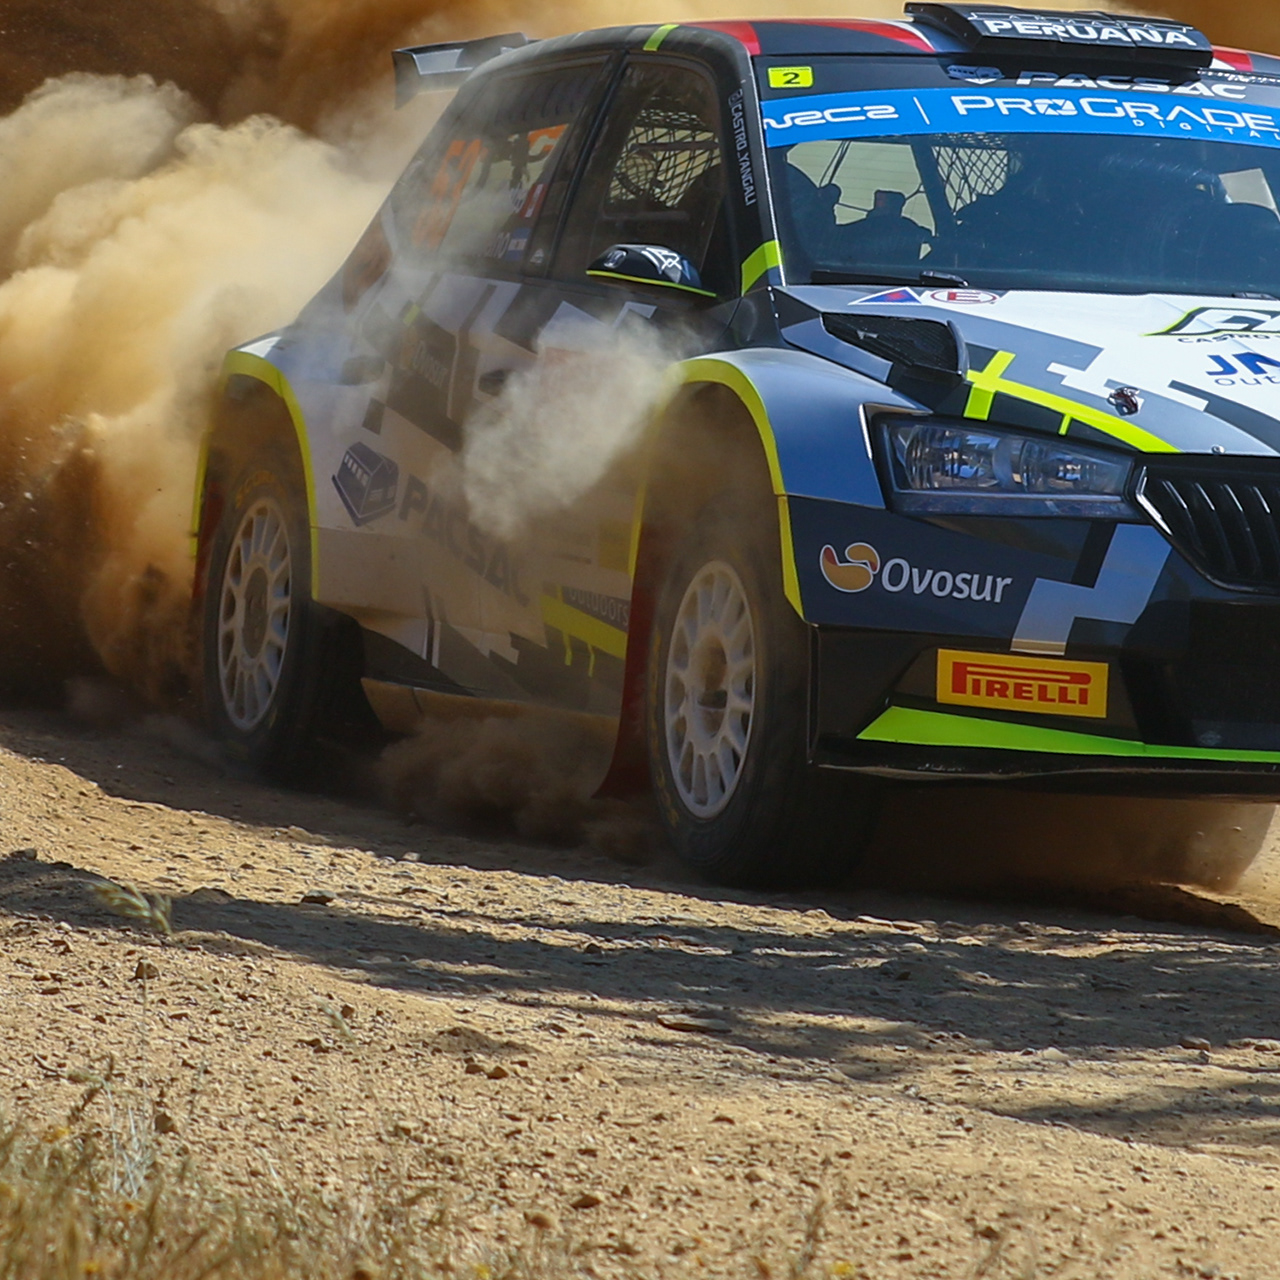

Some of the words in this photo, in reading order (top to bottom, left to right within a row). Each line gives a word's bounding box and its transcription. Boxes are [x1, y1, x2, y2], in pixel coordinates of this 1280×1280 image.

[984, 20, 1197, 46] PERUANA
[782, 72, 800, 84] 2
[1016, 71, 1247, 100] PACSAC
[951, 95, 1280, 133] PROGRADE
[1177, 333, 1269, 344] CASTRO
[881, 557, 1013, 604] Ovosur
[951, 660, 1092, 706] PIRELLI
